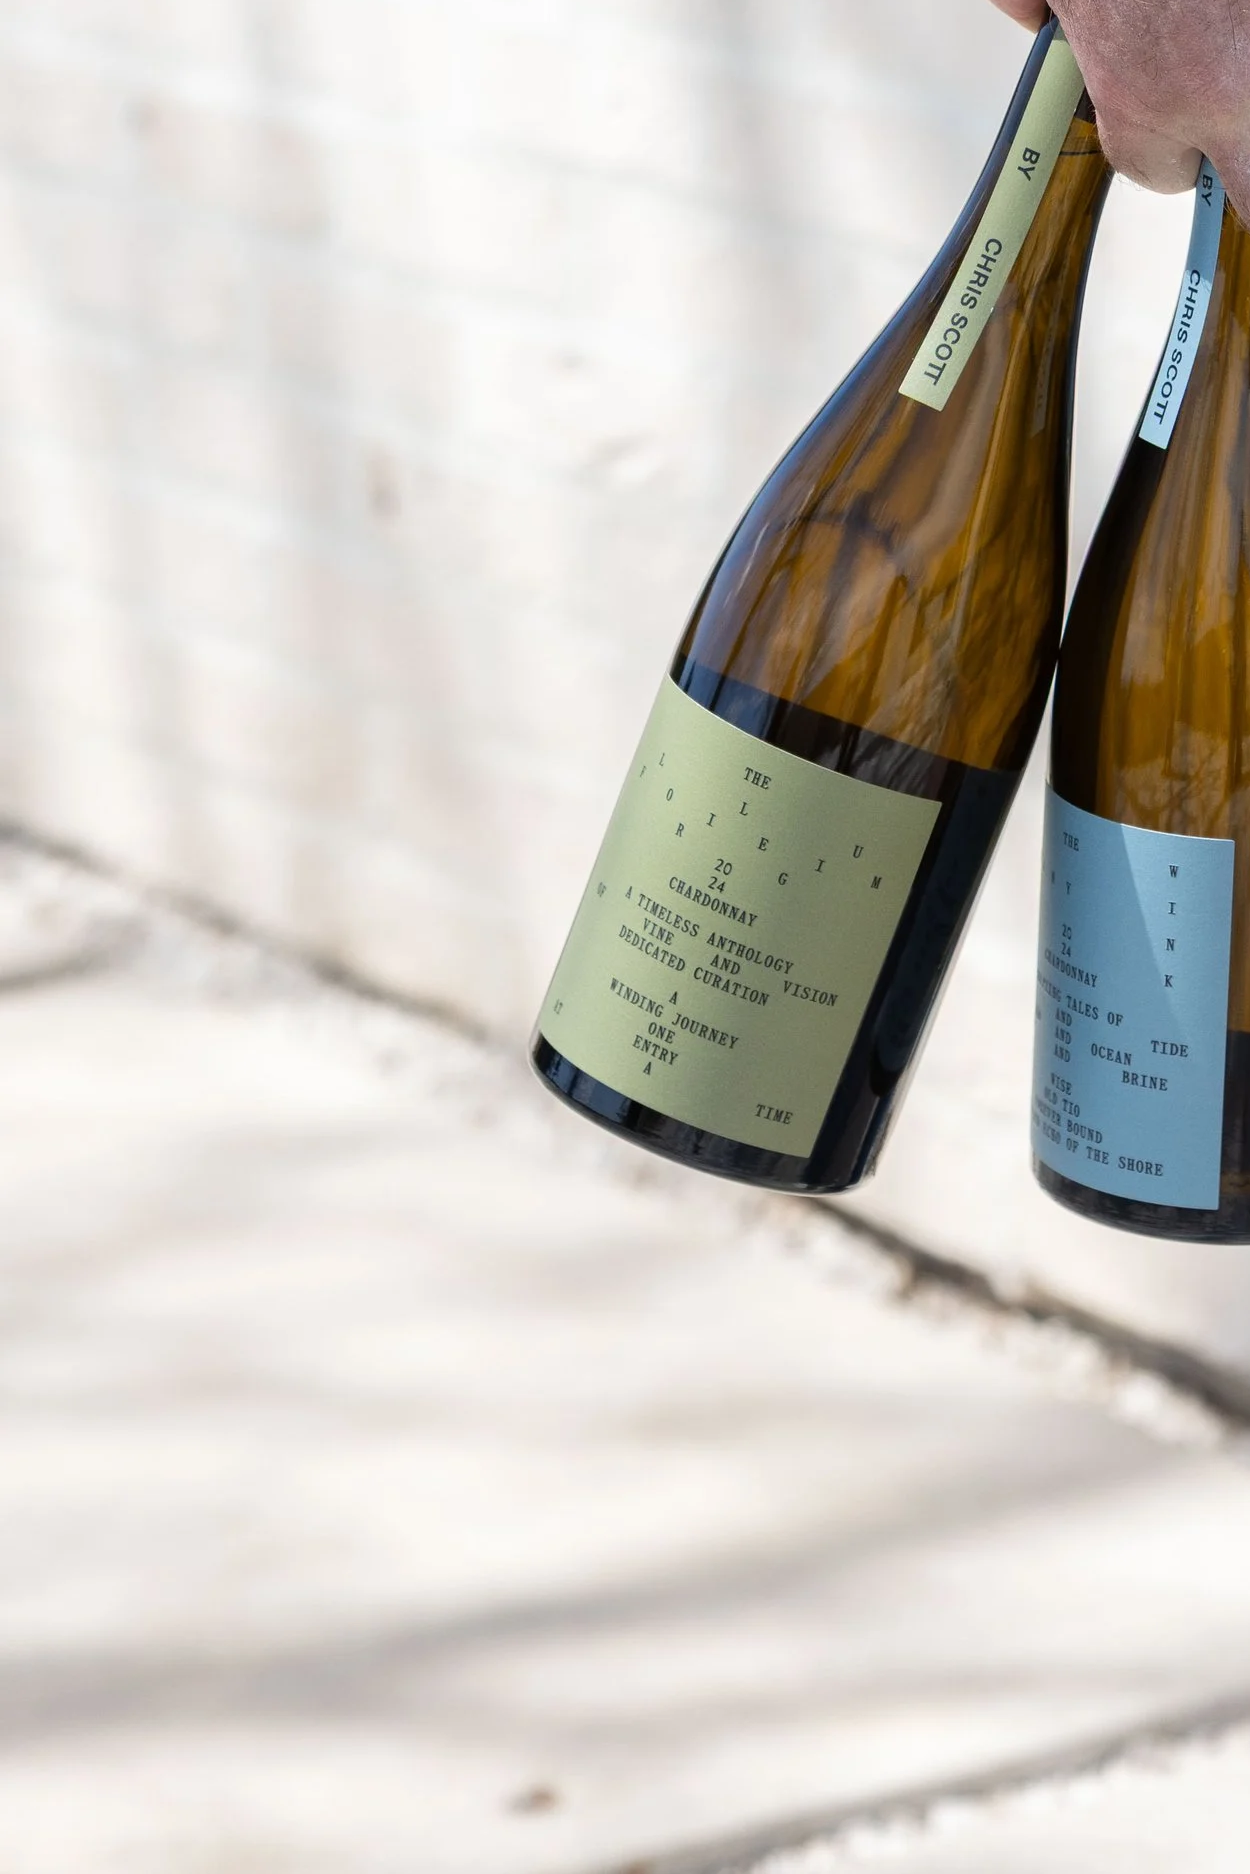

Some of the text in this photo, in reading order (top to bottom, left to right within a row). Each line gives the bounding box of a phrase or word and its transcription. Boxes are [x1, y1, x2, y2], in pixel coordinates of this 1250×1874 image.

[923, 147, 1041, 386] BY CHRIS SCOTT
[1153, 174, 1214, 424] BY CHRIS SCOTT
[743, 767, 772, 790] THE
[1062, 832, 1080, 852] THE
[714, 858, 733, 876] 20
[707, 876, 727, 893] 24
[668, 876, 758, 928] CHARDONNAY
[624, 885, 795, 975] A TIMELESS ANTHOLOGY
[1061, 924, 1073, 941] 20
[642, 917, 676, 946] VINE
[710, 954, 742, 976] AND
[783, 980, 839, 1007] VISION
[1060, 942, 1072, 958] 24
[617, 924, 771, 1007] DEDICATED CURATION
[668, 991, 678, 1006] A
[1066, 995, 1124, 1027] TALES OF
[609, 977, 740, 1050] WINDING JOURNEY
[648, 1022, 676, 1045] ONE
[632, 1034, 679, 1066] ENTRY
[1091, 1043, 1133, 1066] OCEAN
[1151, 1040, 1190, 1058] TIDE
[1121, 1070, 1168, 1091] BRINE
[642, 1062, 652, 1076] A
[755, 1103, 794, 1125] TIME
[1067, 1119, 1104, 1144] BOUND
[1066, 1137, 1080, 1154] OF
[1085, 1146, 1110, 1165] THE
[1118, 1156, 1164, 1177] SHORE
